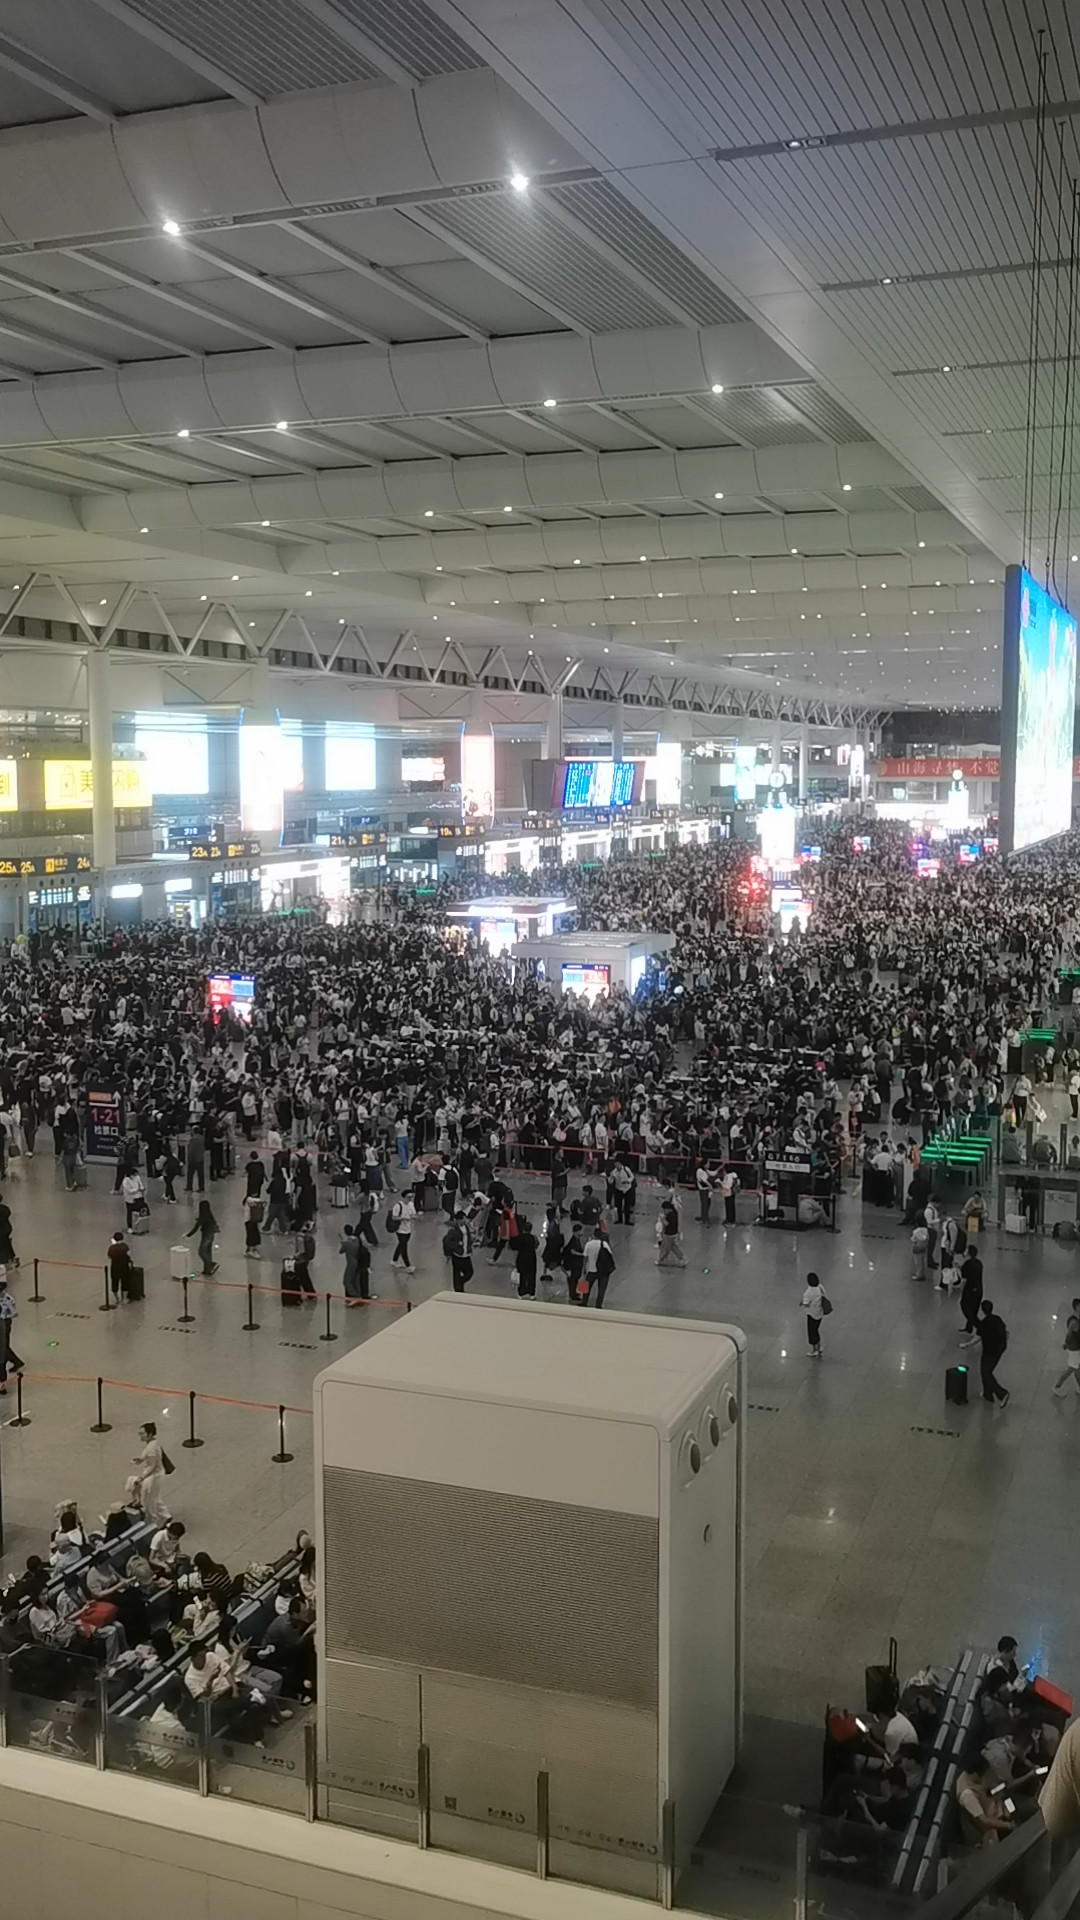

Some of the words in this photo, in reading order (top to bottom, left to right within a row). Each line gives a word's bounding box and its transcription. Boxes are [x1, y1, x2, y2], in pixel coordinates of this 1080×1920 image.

[0, 861, 17, 874] 25A
[21, 861, 36, 873] 25A
[77, 857, 91, 869] 24A
[92, 1108, 120, 1123] 1-21
